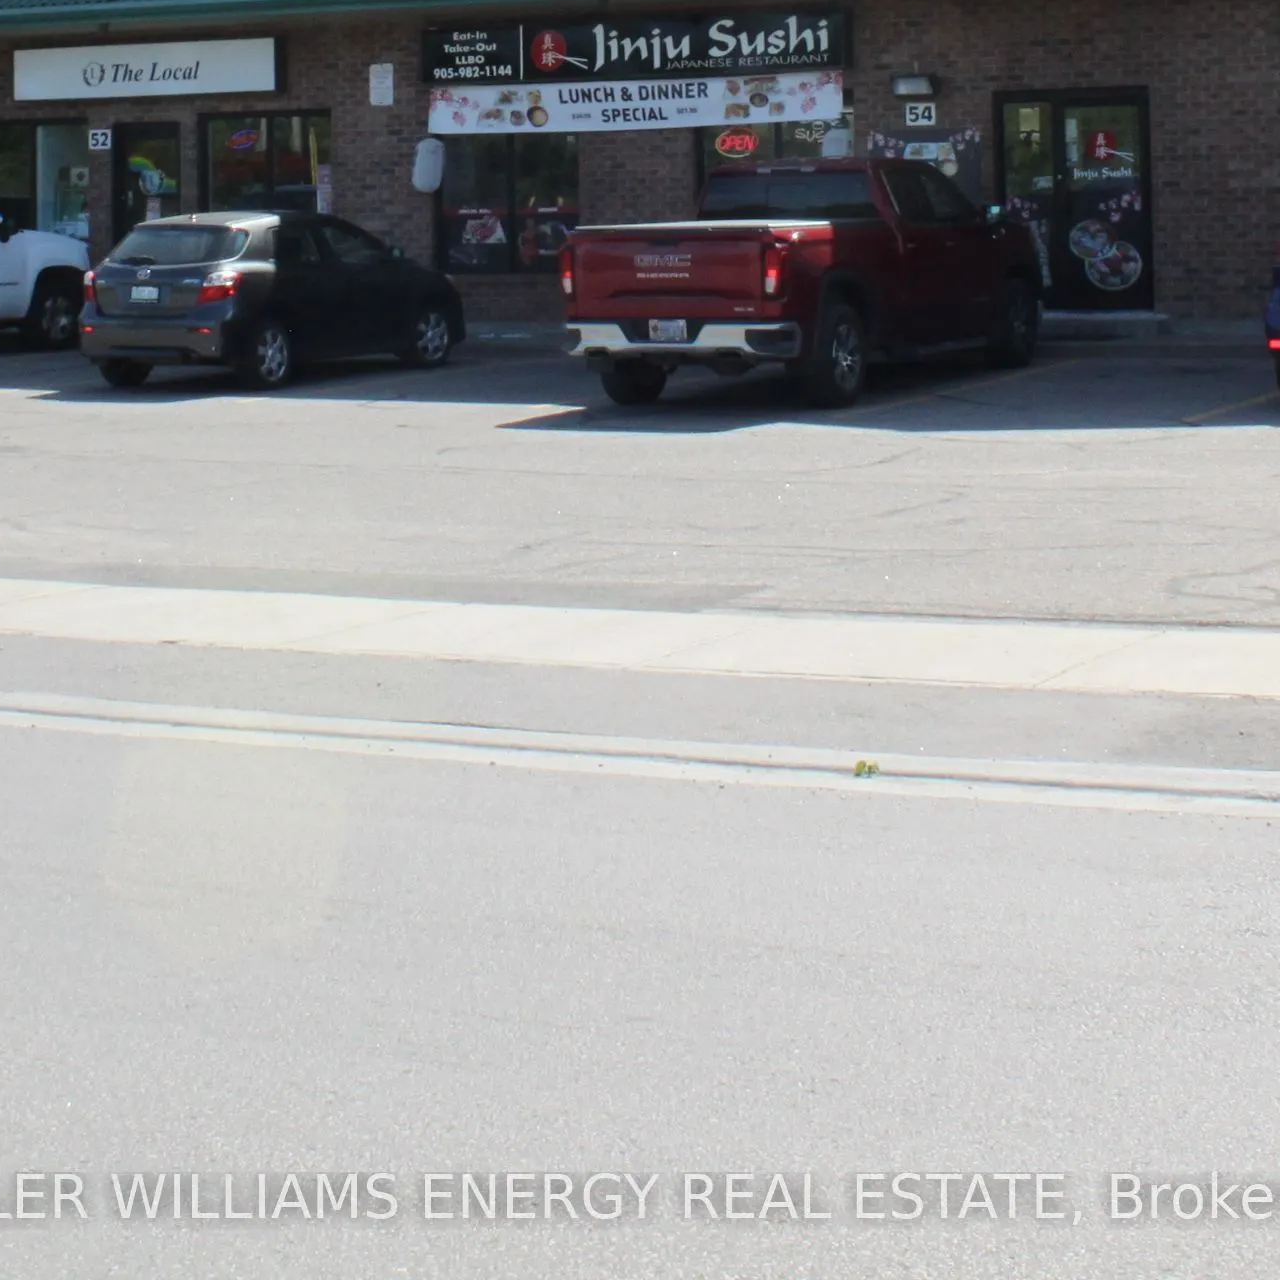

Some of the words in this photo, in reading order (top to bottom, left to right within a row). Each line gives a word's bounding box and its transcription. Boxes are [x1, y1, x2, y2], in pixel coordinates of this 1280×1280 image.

[452, 31, 488, 41] Eat-In
[592, 23, 691, 73] Jinju
[708, 15, 829, 58] Sushi
[443, 43, 497, 53] Take-Out
[455, 55, 485, 65] LLBO
[665, 57, 734, 70] JAPANESE
[738, 53, 831, 67] RESTAURANT
[111, 63, 144, 83] The
[150, 60, 200, 81] Local
[433, 64, 513, 80] 905-982-1144
[558, 85, 616, 105] LUNCH
[620, 86, 634, 102] &
[638, 82, 709, 101] DINNER
[600, 106, 669, 124] SPECIAL
[908, 105, 933, 122] 54
[90, 132, 109, 148] 52
[719, 133, 756, 152] OPEN
